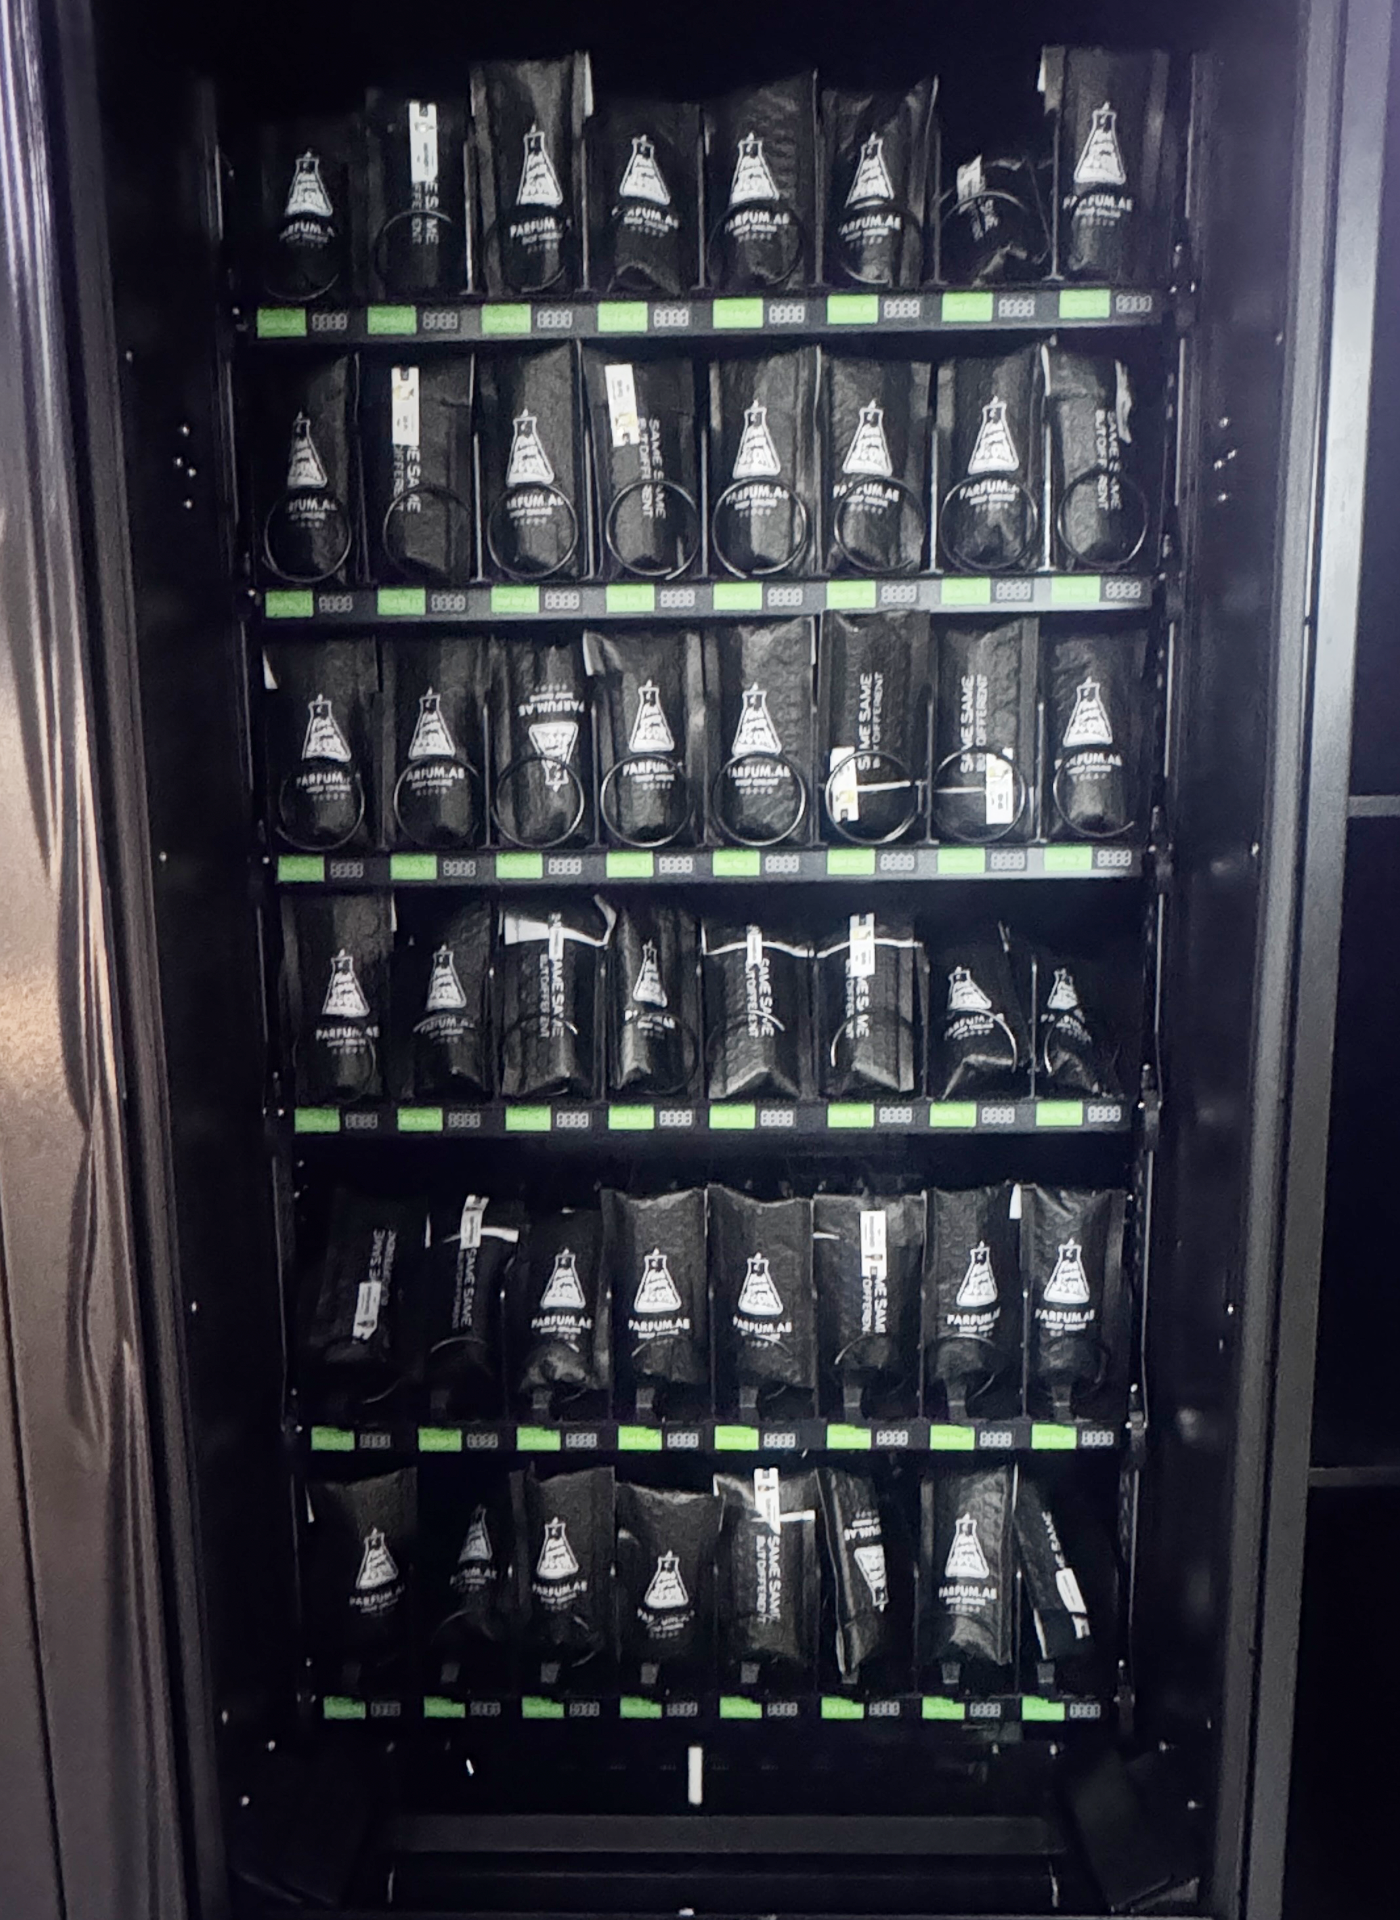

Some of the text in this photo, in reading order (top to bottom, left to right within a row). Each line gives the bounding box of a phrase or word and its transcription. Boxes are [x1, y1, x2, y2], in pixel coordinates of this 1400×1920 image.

[426, 196, 439, 244] SME
[857, 672, 872, 770] SME SAME
[961, 675, 974, 723] SAME
[552, 958, 563, 991] AME
[460, 1249, 476, 1326] SAME SAME
[768, 1535, 781, 1578] SAME
